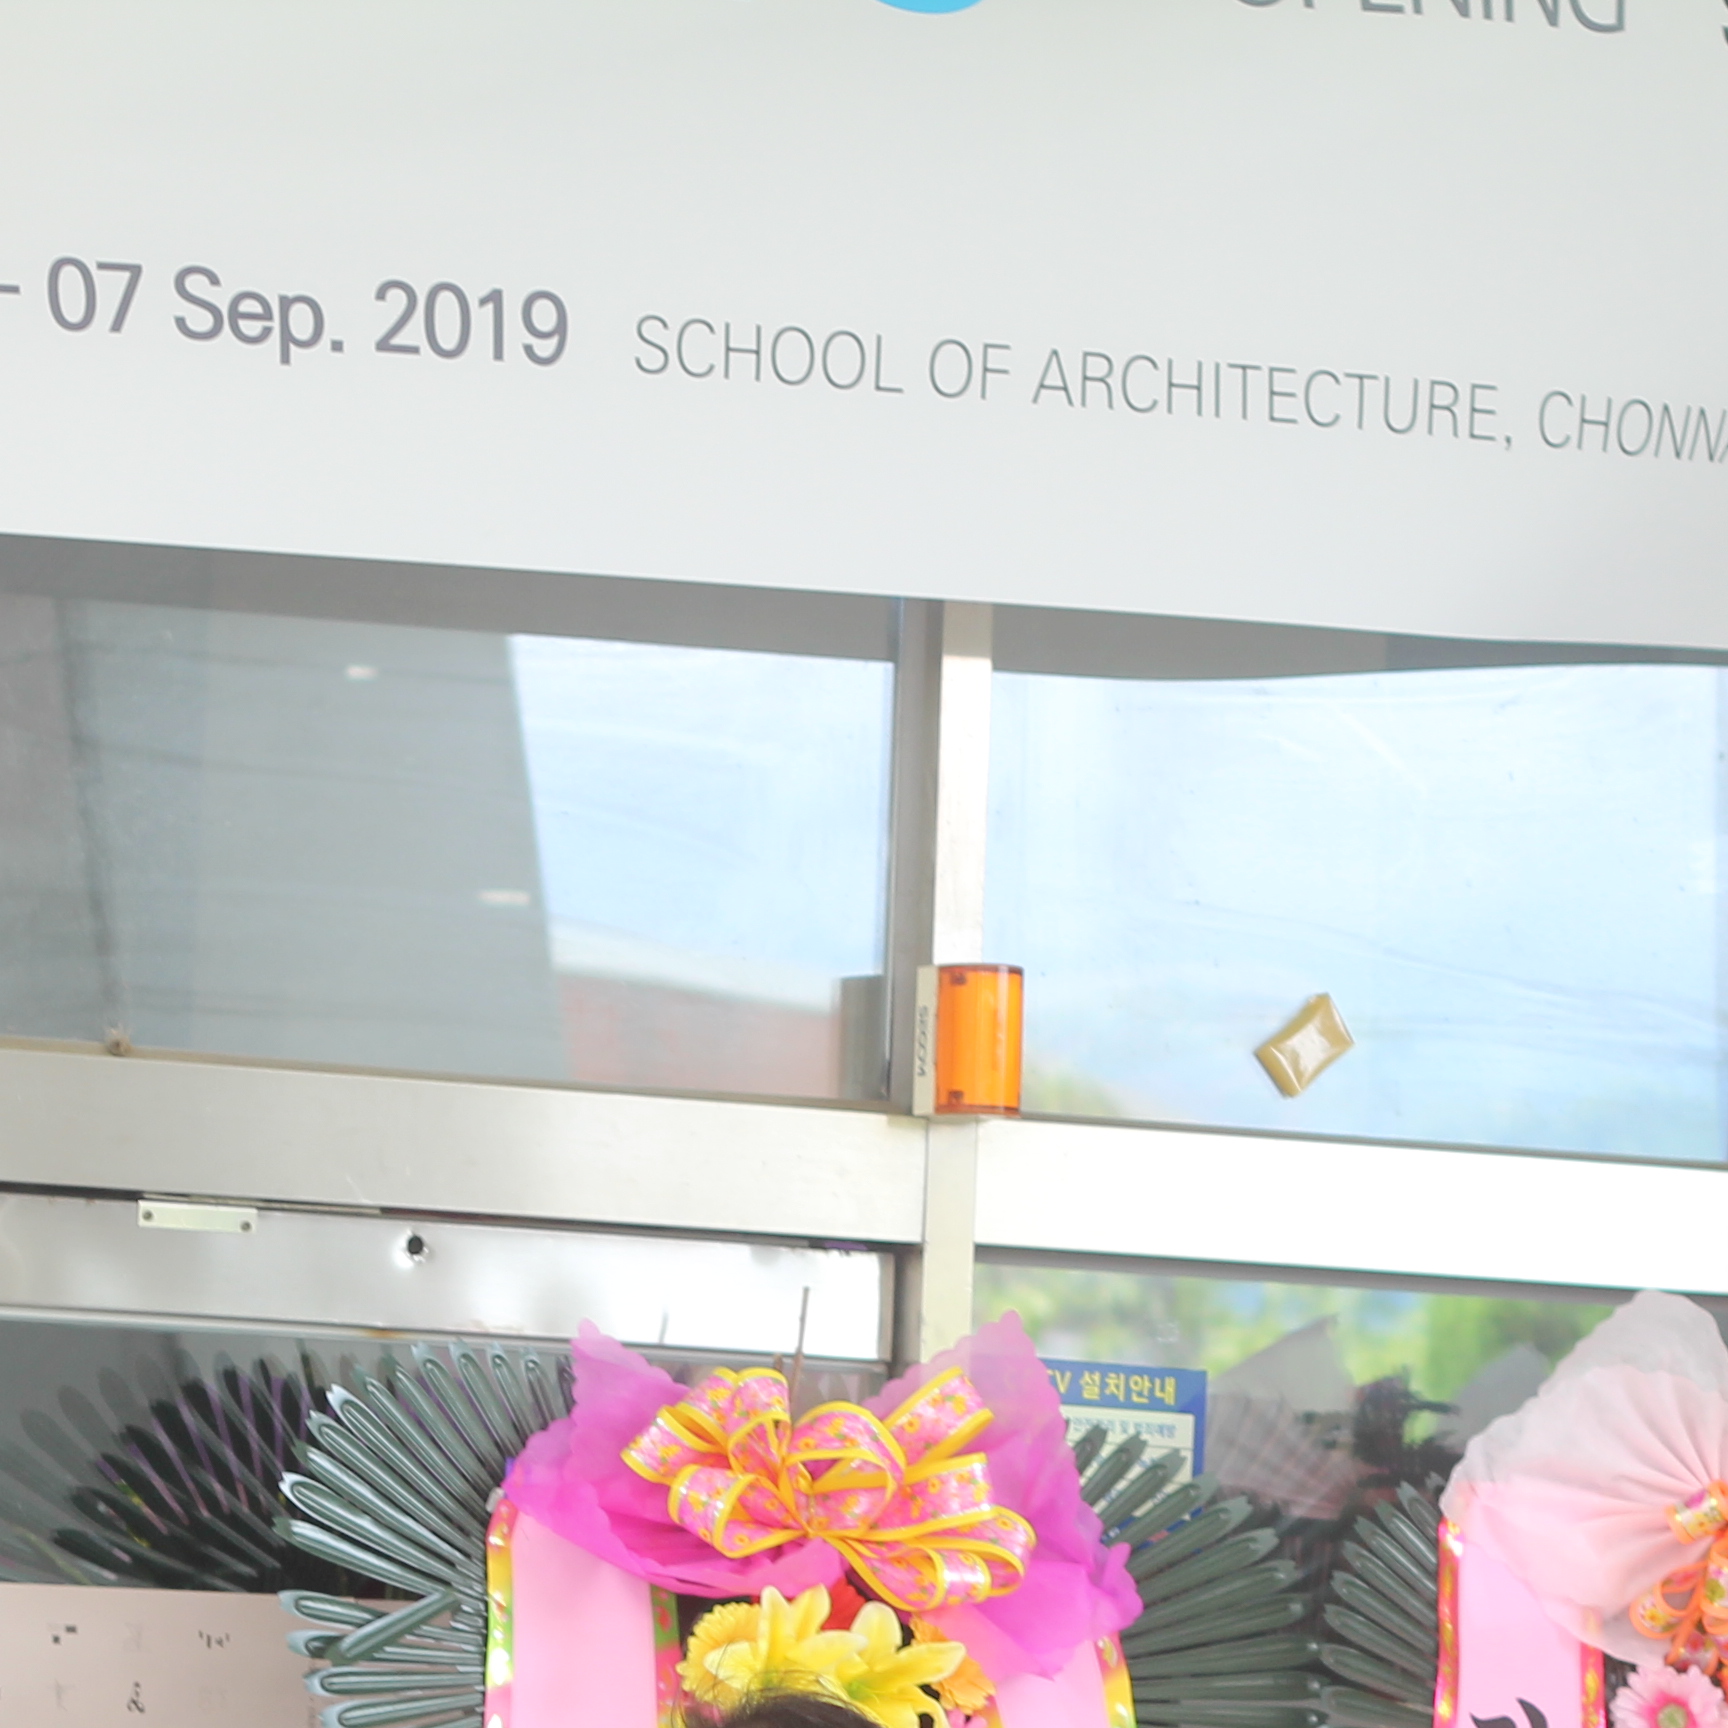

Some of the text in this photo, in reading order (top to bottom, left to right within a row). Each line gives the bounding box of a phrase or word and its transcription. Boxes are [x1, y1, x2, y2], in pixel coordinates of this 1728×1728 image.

[47, 256, 143, 335] 07
[173, 265, 344, 367] Sep.
[374, 279, 569, 368] 2019
[634, 314, 905, 395] SCHOOL
[928, 338, 1012, 401] OF
[1031, 348, 1513, 452] ARCHITECTURE,
[1080, 1370, 1177, 1406] 설치안내
